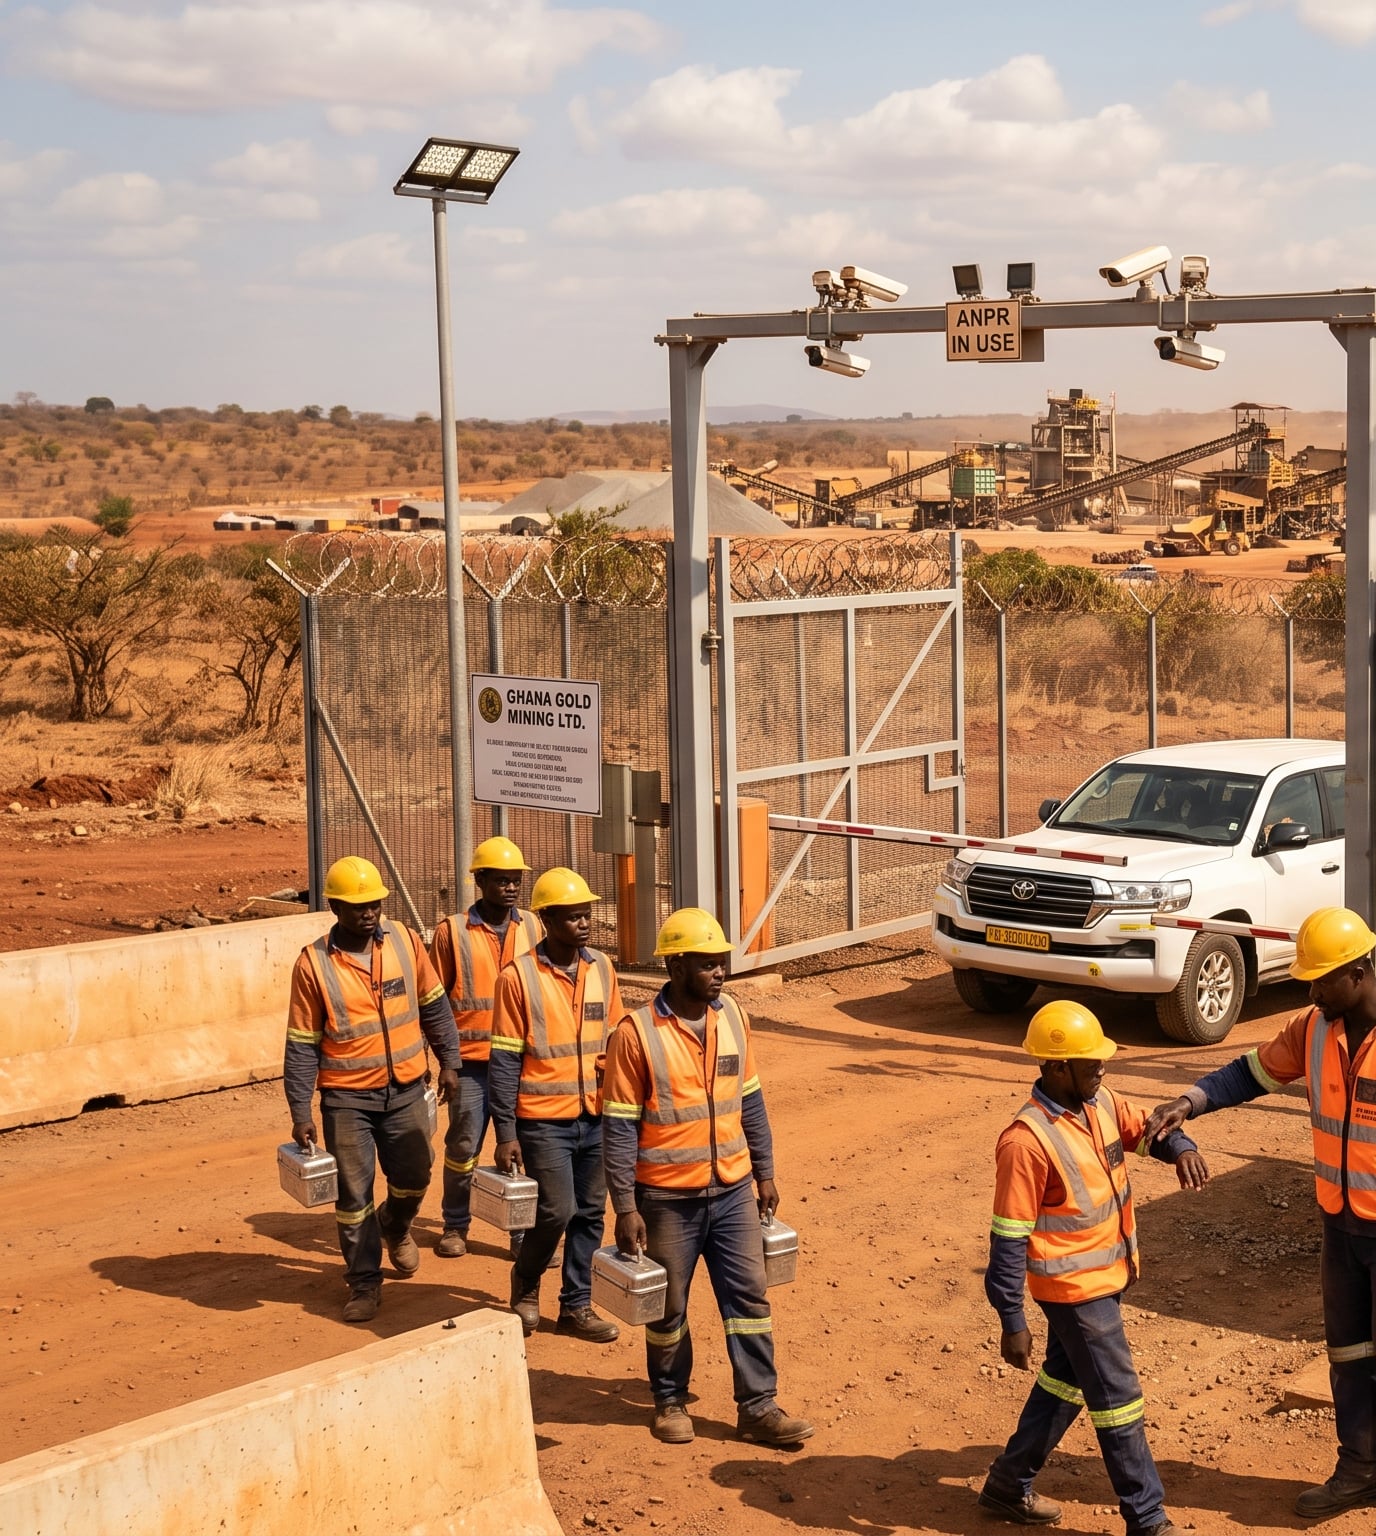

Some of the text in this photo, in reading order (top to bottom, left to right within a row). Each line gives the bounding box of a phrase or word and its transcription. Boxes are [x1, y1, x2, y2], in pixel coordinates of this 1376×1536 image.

[956, 308, 1010, 328] ANPR
[952, 333, 1015, 354] IN USE
[506, 689, 592, 710] GHANA GOLD
[507, 709, 586, 730] MINING LTD.
